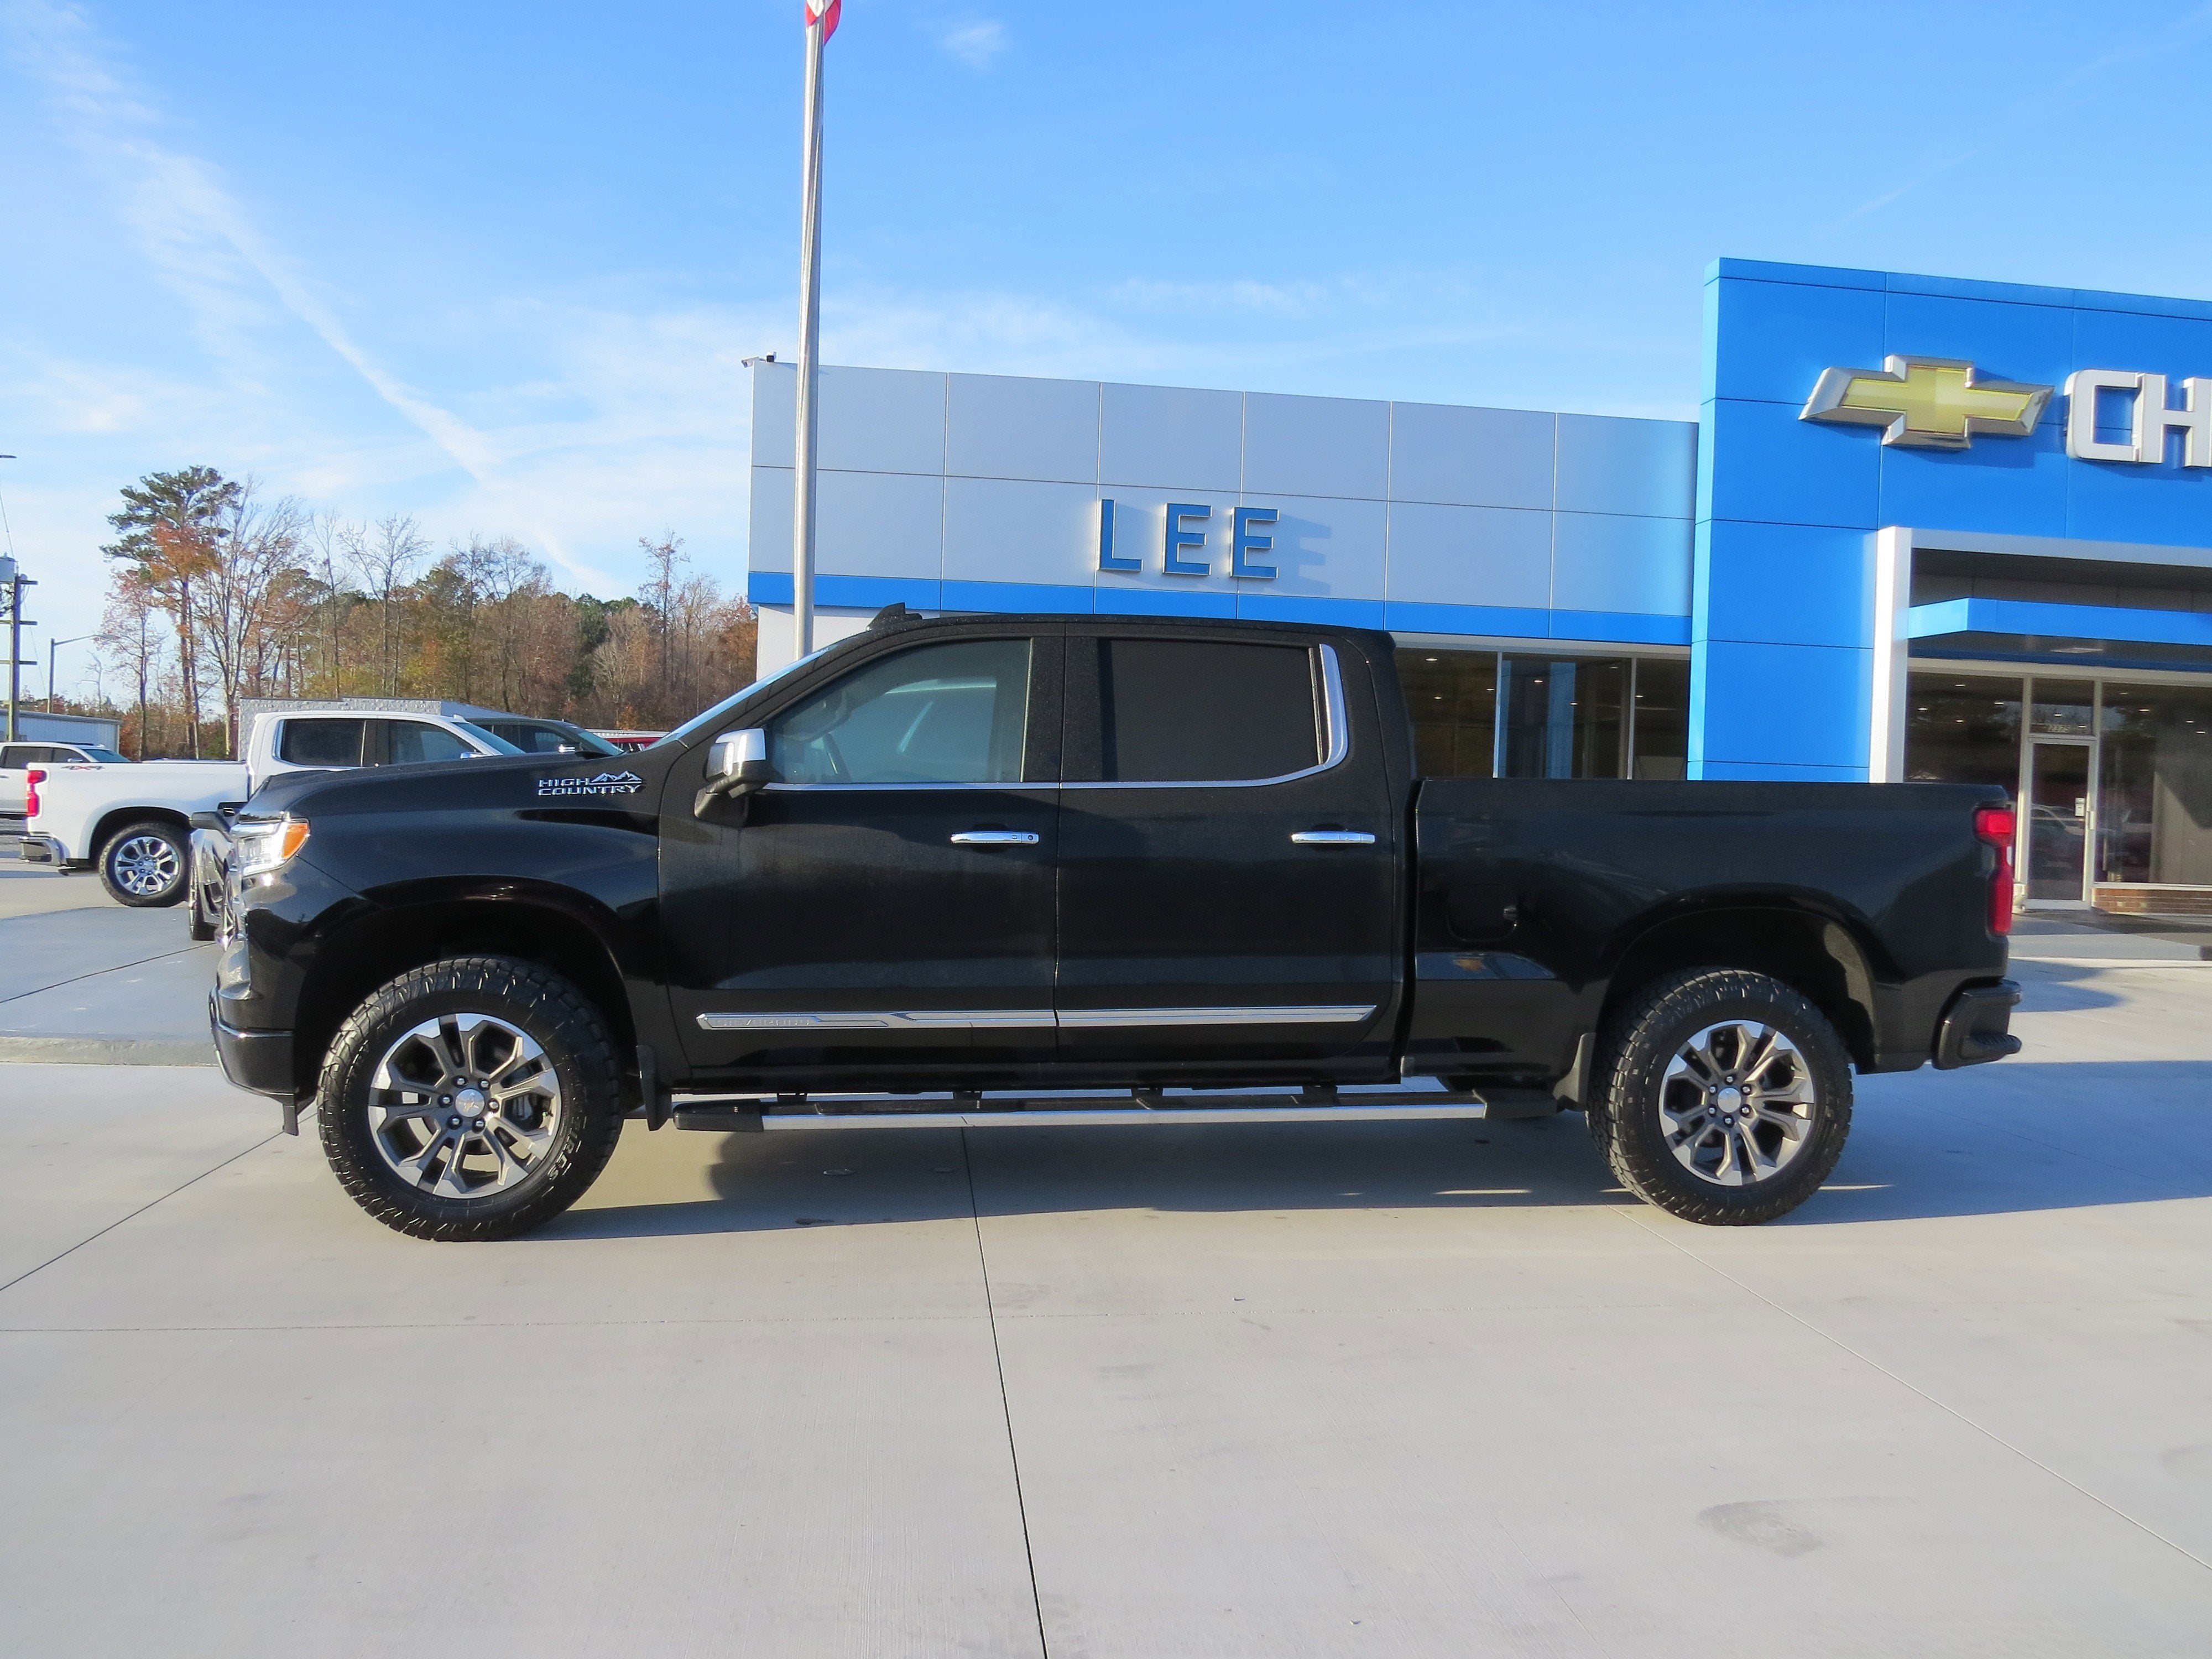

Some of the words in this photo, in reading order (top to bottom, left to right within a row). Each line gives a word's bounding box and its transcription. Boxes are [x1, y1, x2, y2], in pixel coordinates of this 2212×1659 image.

[1099, 499, 1280, 578] LEE
[539, 778, 591, 787] HIGH
[538, 785, 640, 795] COUNTRY
